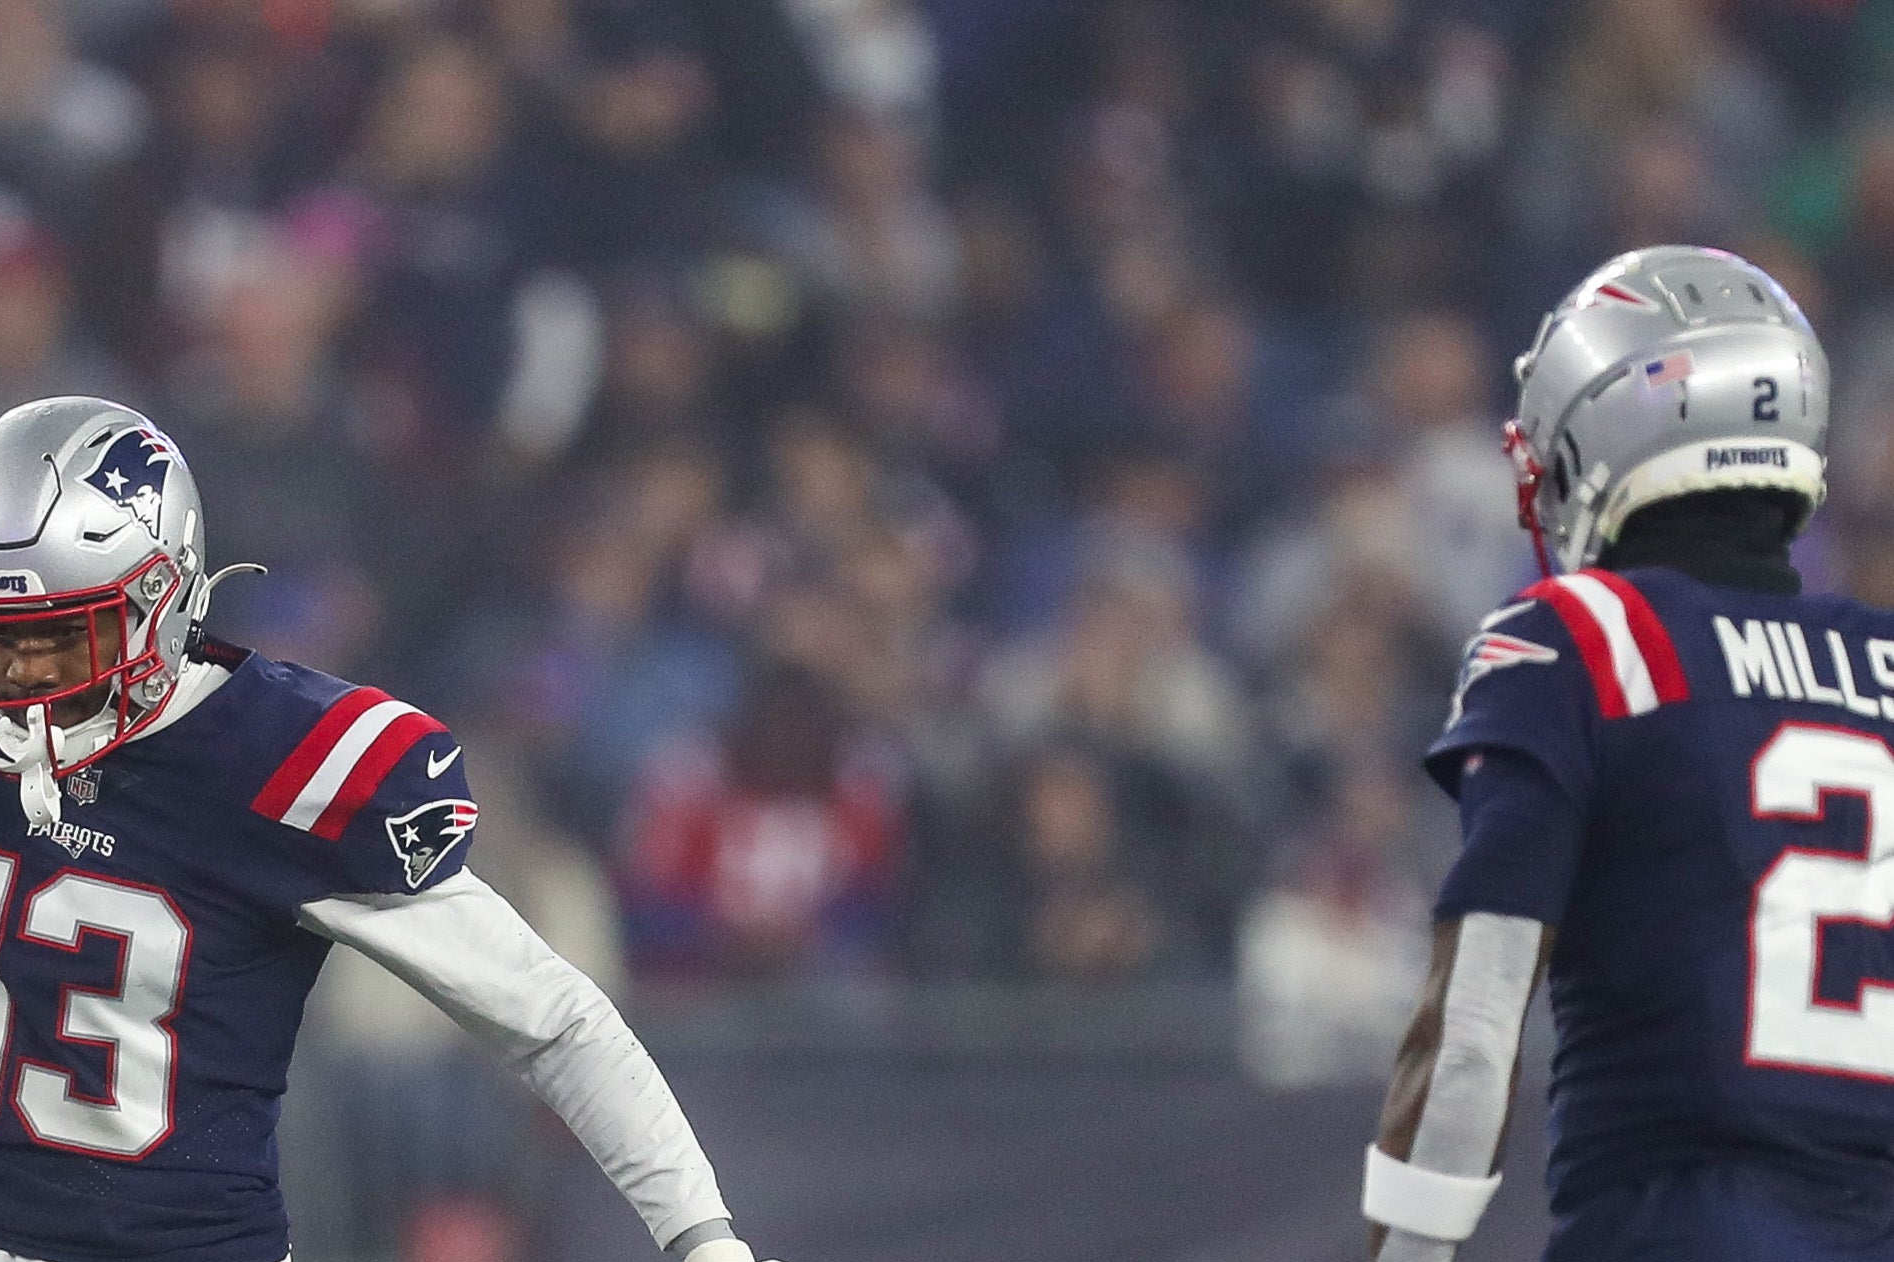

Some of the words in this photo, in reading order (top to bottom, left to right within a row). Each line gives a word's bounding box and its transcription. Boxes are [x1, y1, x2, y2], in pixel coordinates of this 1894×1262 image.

[1752, 376, 1780, 422] 2
[1706, 448, 1789, 472] PATRIOTS
[71, 779, 94, 799] NFL
[26, 820, 116, 858] PATRIOTS
[1743, 719, 1894, 1085] 2
